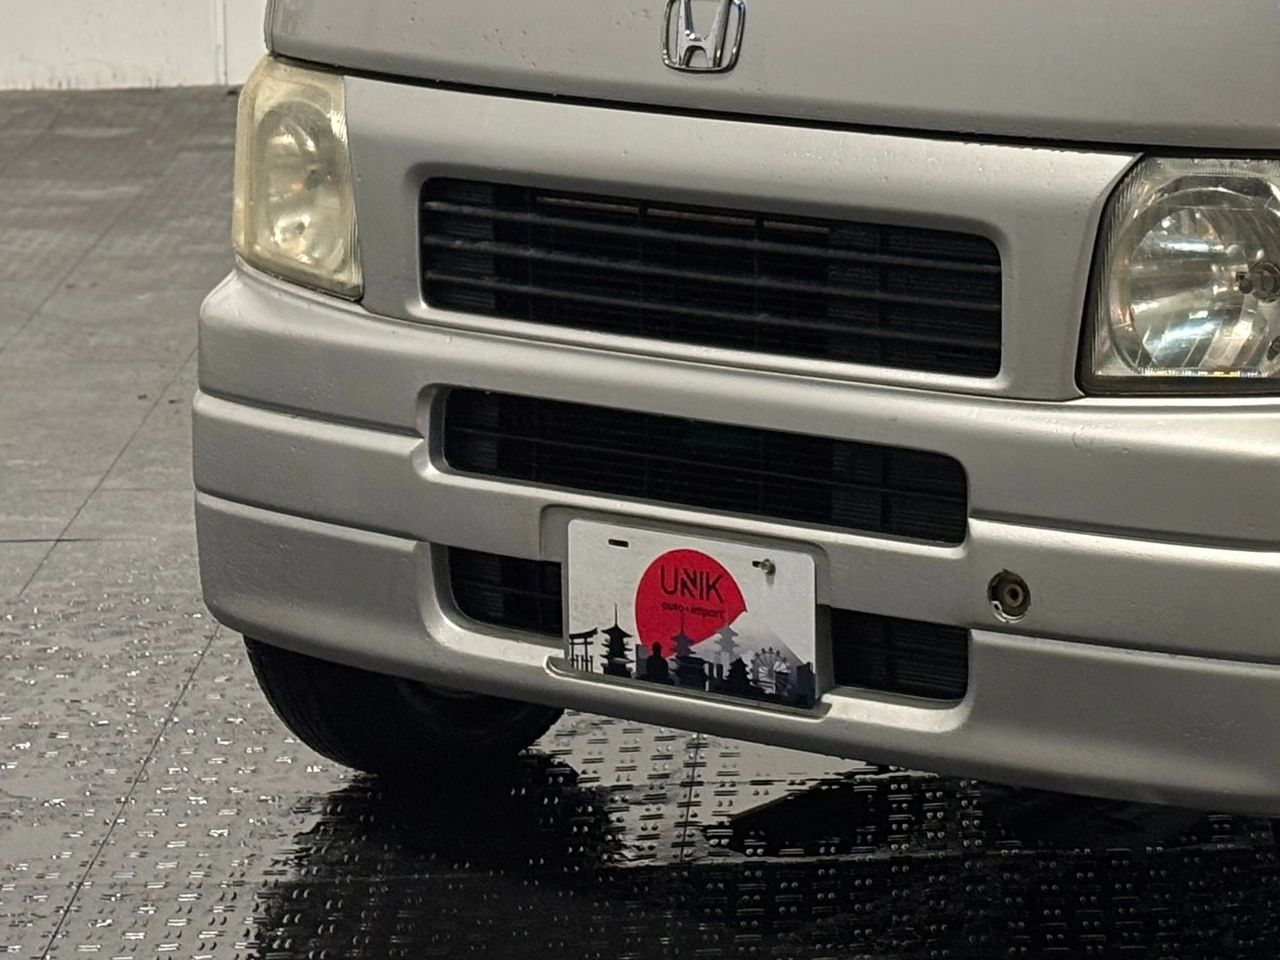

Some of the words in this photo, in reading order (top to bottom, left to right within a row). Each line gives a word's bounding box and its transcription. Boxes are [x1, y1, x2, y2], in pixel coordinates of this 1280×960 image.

[660, 564, 724, 604] UNIK
[661, 601, 684, 613] auto
[690, 606, 726, 620] import
